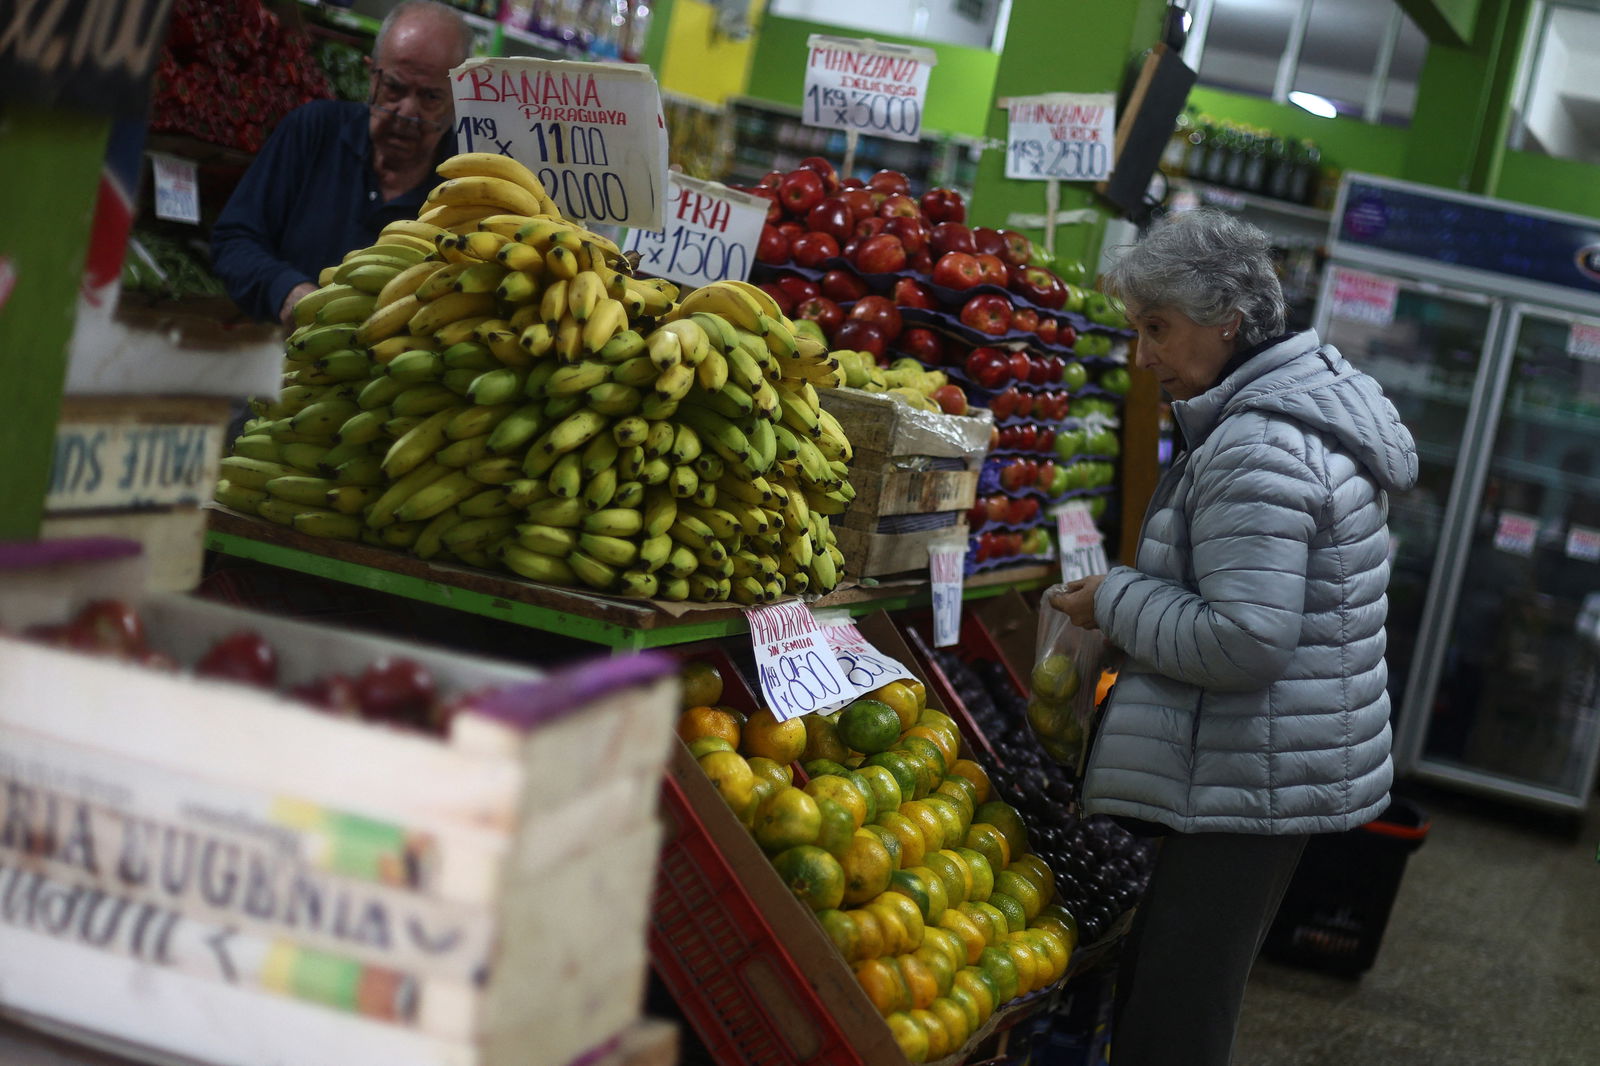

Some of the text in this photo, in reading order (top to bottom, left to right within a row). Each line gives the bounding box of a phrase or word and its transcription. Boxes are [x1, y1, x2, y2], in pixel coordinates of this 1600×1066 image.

[457, 65, 602, 107] BANANA
[810, 47, 919, 83] MANZANA
[518, 104, 627, 126] PARAGUAYA
[851, 91, 920, 136] 3000
[529, 123, 609, 166] 1100
[538, 167, 628, 221] 2000
[667, 225, 747, 282] 1500
[744, 602, 818, 648] MANDARINA
[779, 650, 841, 711] 850
